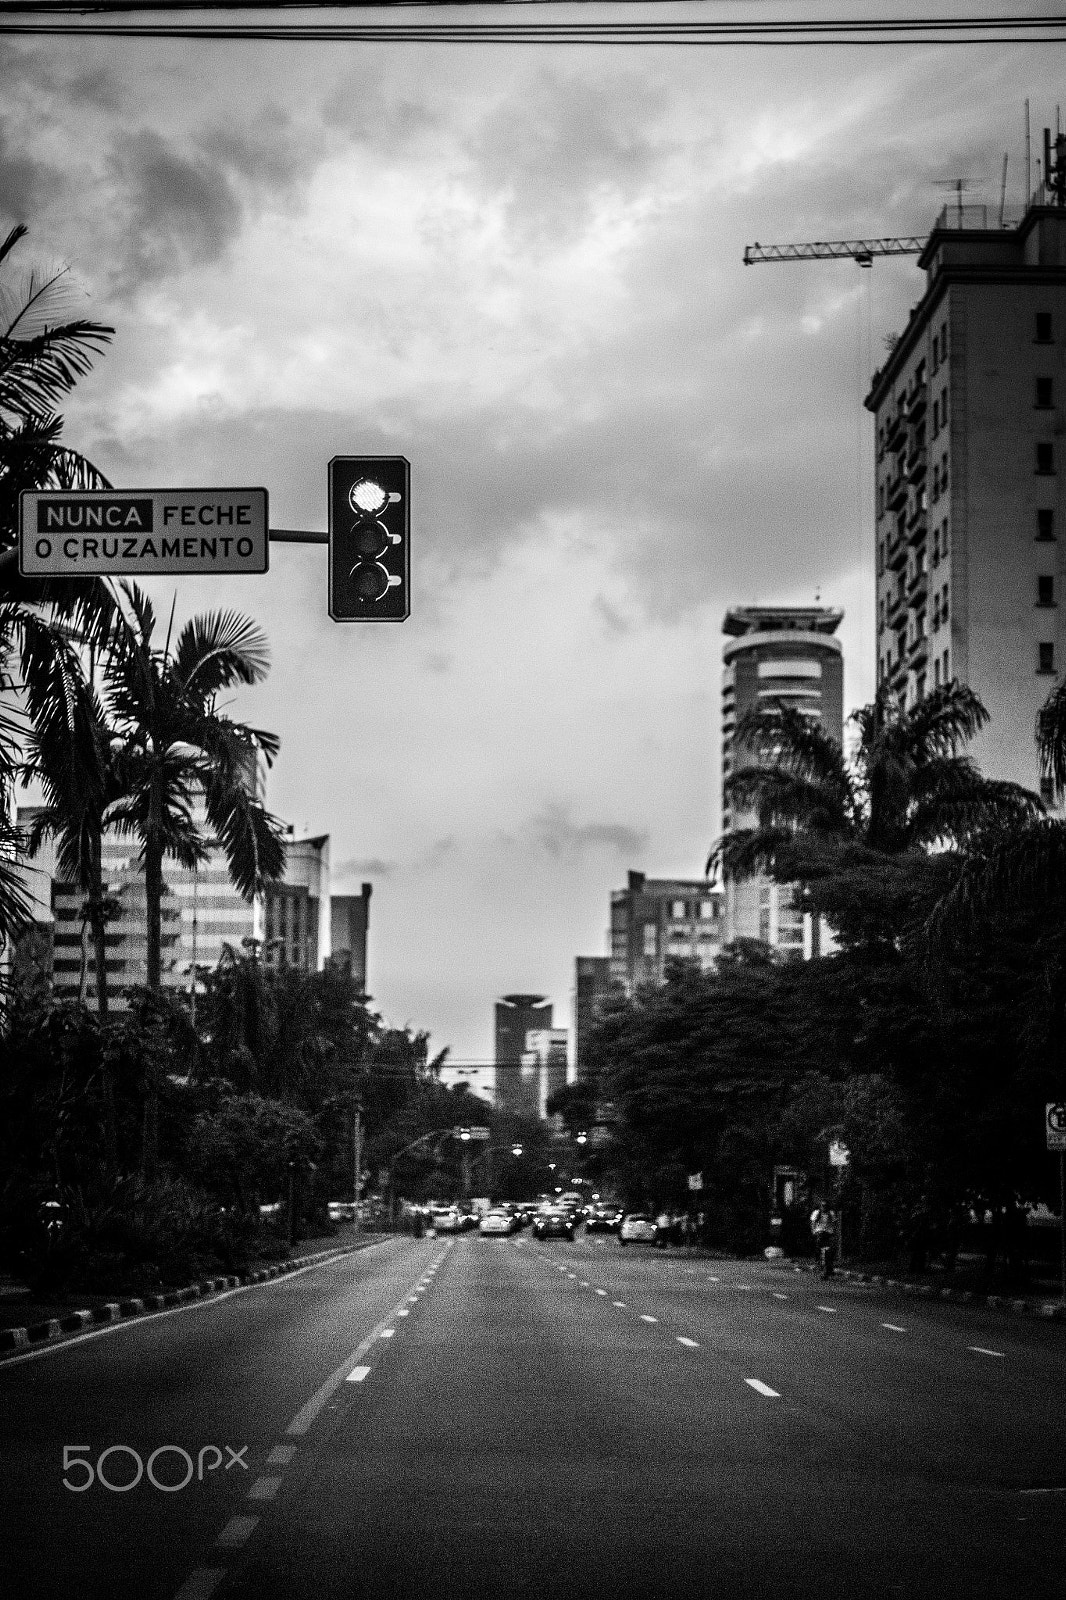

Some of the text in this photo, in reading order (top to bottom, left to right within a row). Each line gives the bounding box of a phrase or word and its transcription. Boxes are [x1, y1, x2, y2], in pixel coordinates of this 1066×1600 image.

[46, 505, 252, 527] NUNCA FECHE
[35, 537, 254, 559] O CRUZAMENTO
